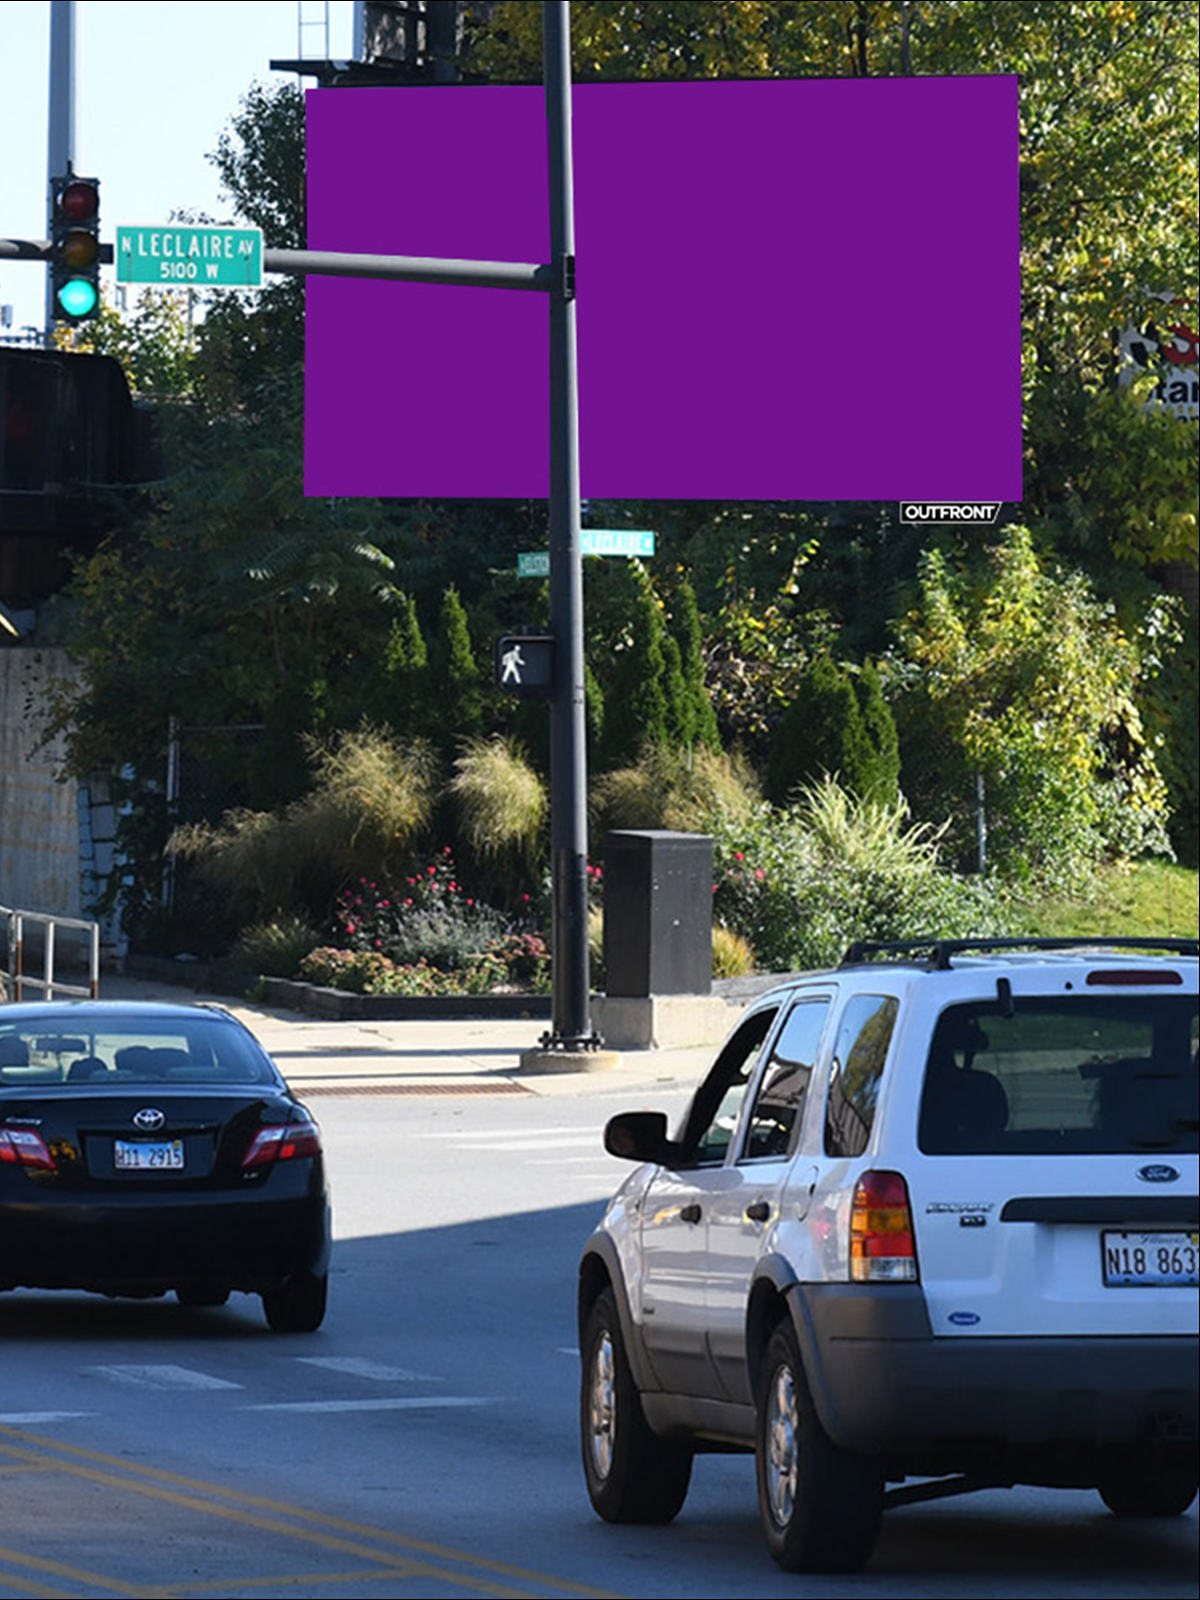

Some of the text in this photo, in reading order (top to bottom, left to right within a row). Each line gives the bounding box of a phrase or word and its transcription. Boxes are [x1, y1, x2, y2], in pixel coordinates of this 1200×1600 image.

[122, 233, 254, 258] N LECLAIRE AV
[161, 262, 219, 279] 5100 W
[905, 505, 996, 519] OUTFRONT
[148, 1147, 182, 1167] 2915
[1107, 1247, 1199, 1275] N18 863
